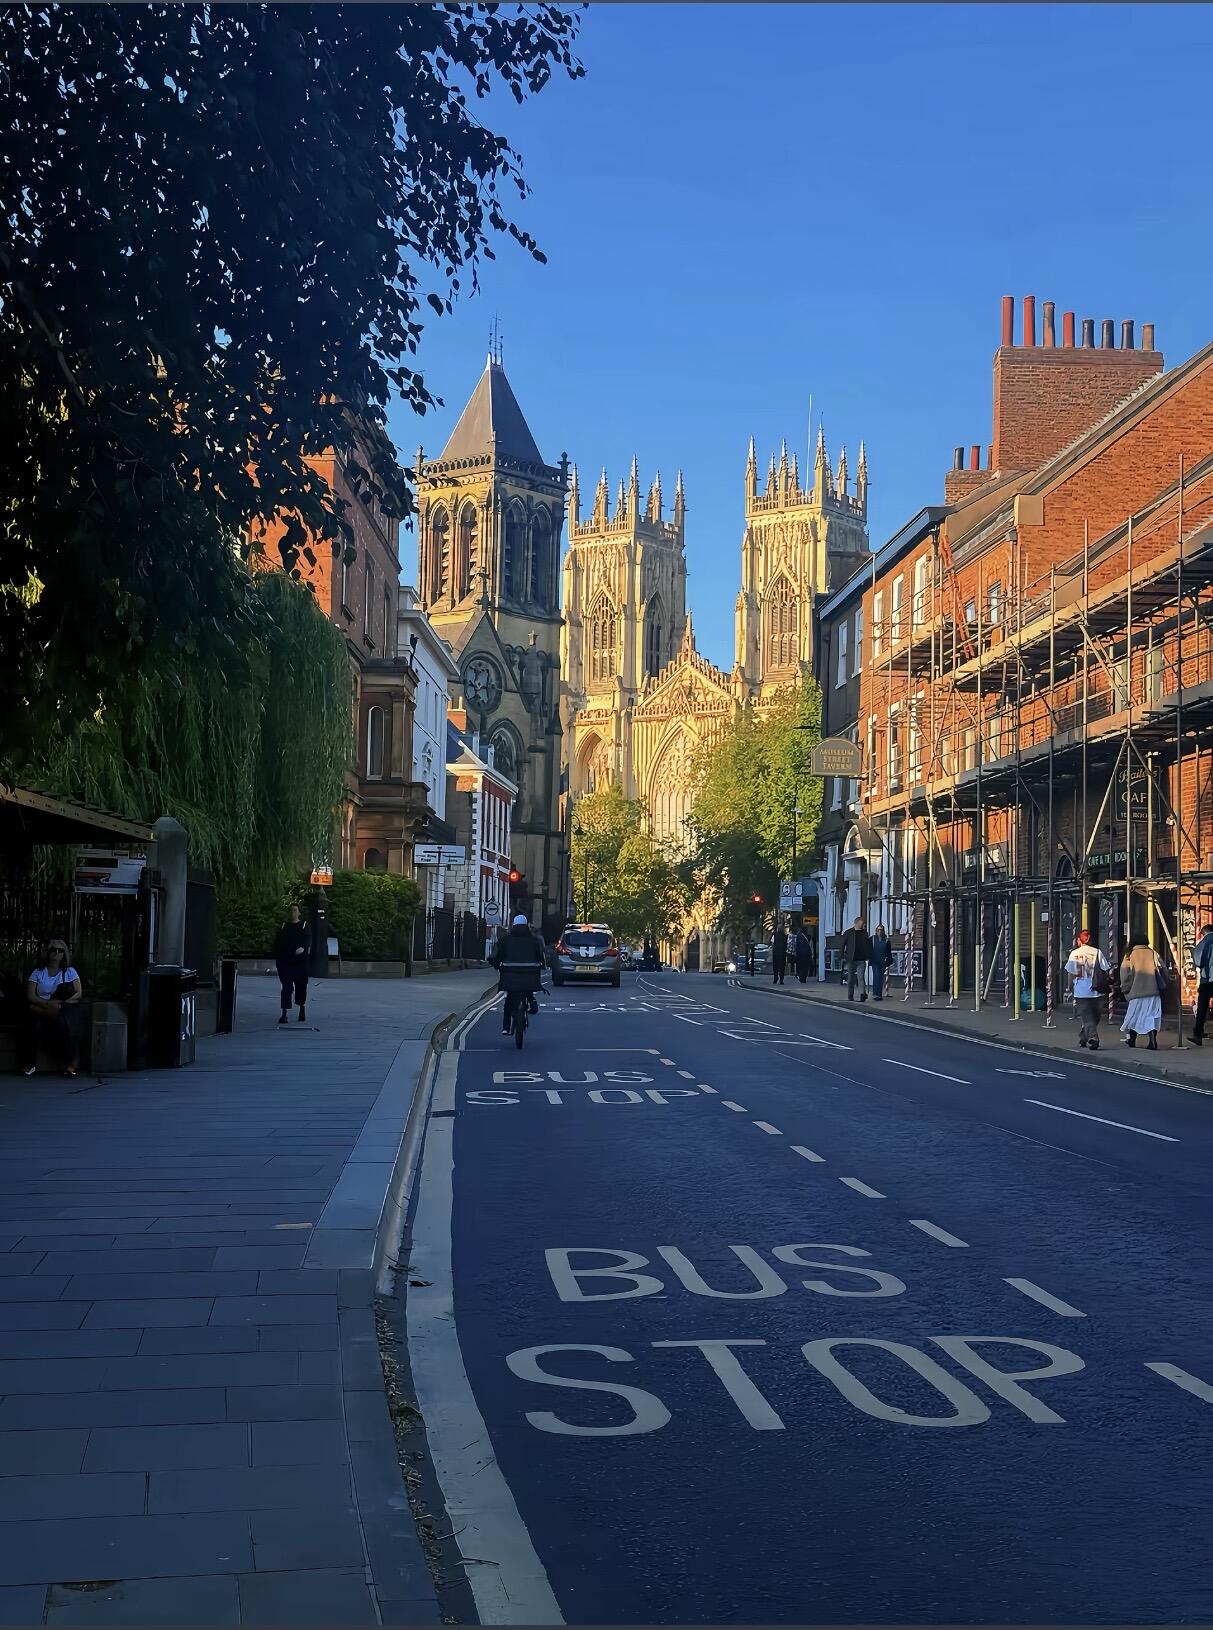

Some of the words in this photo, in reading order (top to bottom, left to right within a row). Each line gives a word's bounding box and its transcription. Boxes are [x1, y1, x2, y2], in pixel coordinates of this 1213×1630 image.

[1121, 791, 1151, 803] CAF
[492, 1070, 655, 1084] BUS
[465, 1089, 700, 1105] STOP
[545, 1243, 907, 1301] BUS
[505, 1336, 1086, 1436] STOP
